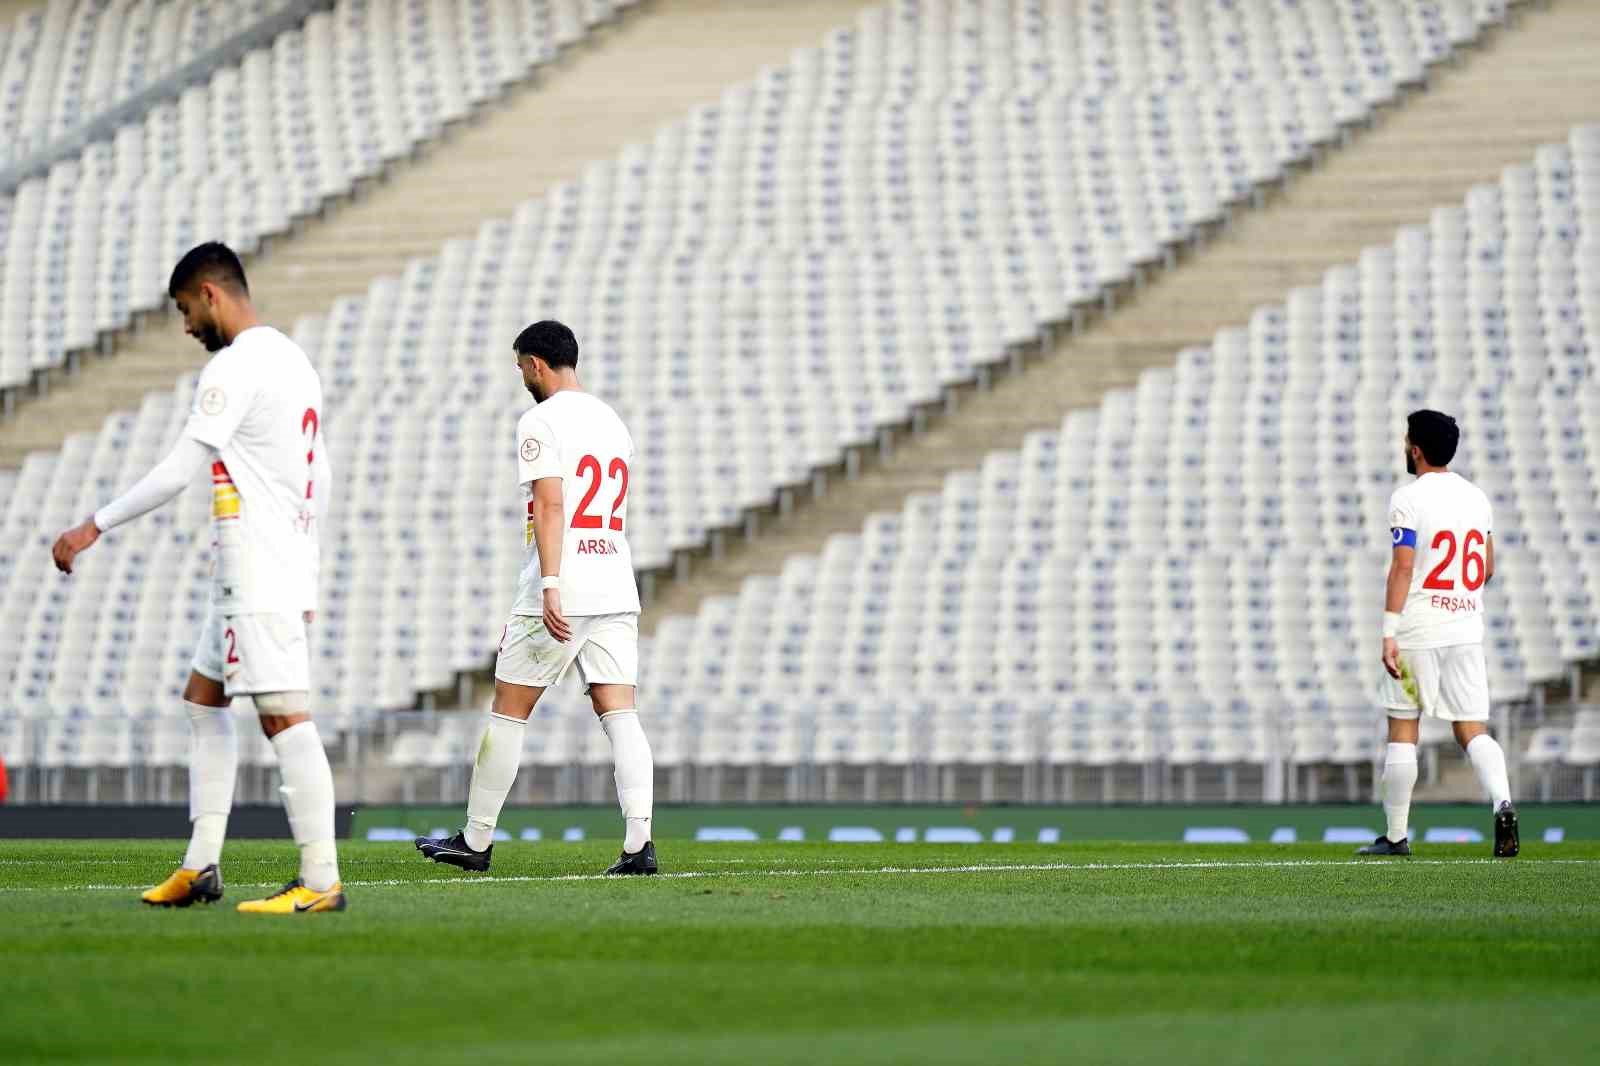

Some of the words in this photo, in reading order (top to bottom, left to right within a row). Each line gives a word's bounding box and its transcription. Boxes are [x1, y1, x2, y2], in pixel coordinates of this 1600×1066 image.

[570, 454, 629, 531] 22
[1422, 528, 1485, 592] 26
[224, 628, 240, 664] 2
